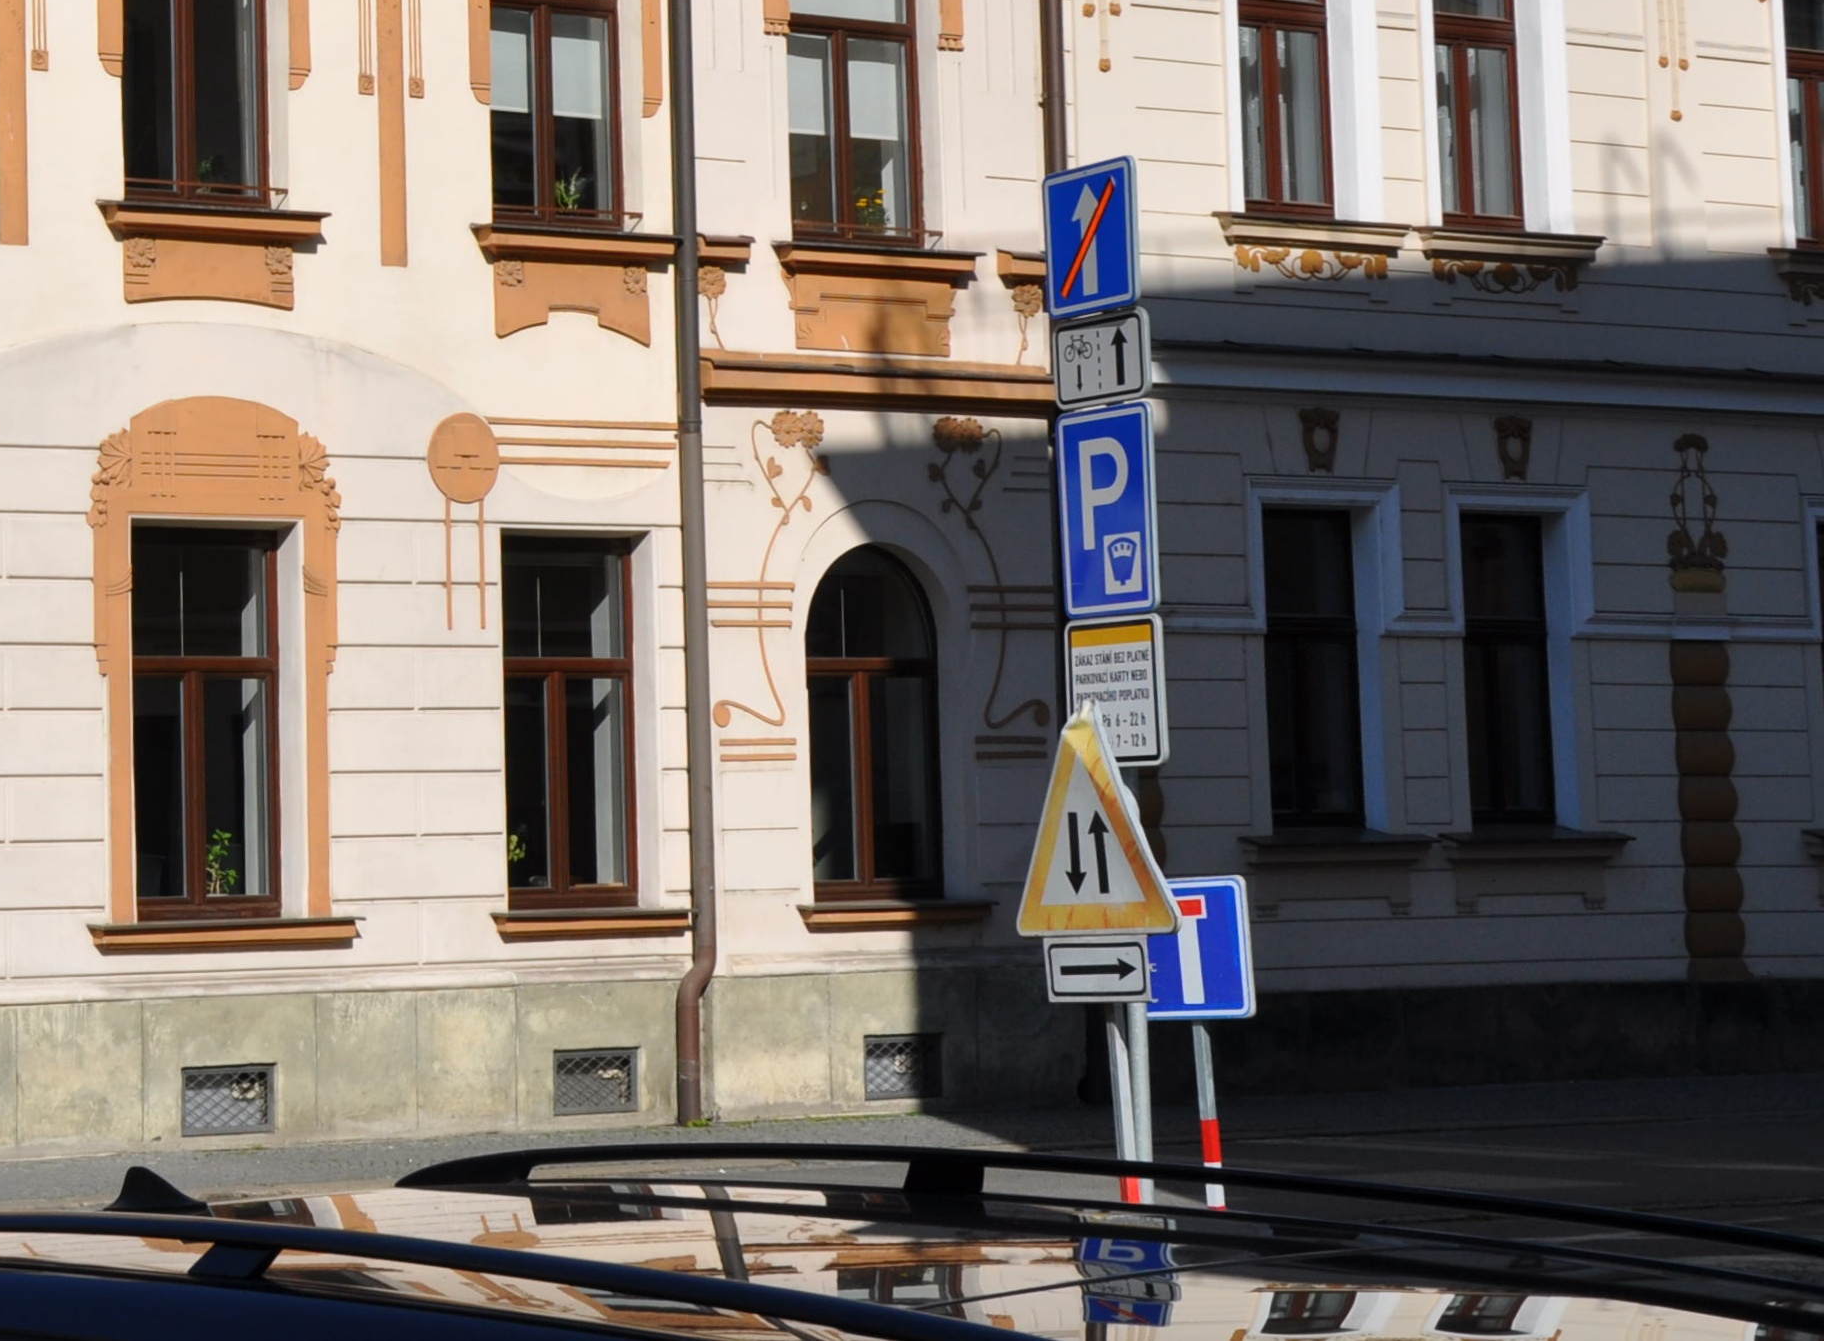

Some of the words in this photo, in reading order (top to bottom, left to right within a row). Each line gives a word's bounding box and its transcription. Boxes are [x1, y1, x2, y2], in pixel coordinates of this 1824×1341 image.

[1078, 437, 1129, 551] P
[1075, 651, 1093, 667] ZÁKAZ
[1095, 649, 1112, 665] STÁNÍ
[1114, 651, 1124, 664] BEZ
[1127, 646, 1150, 662] PLATNÉ
[1076, 669, 1108, 686] PARKOVACÍ
[1110, 670, 1129, 683] KARTY
[1131, 669, 1147, 681] NEBO
[1119, 688, 1150, 701] POPLATKU
[1116, 713, 1121, 727] 6
[1130, 711, 1139, 727] 22
[1141, 712, 1147, 726] h
[1116, 734, 1121, 747] 7
[1131, 734, 1140, 747] 12
[1142, 733, 1147, 746] h
